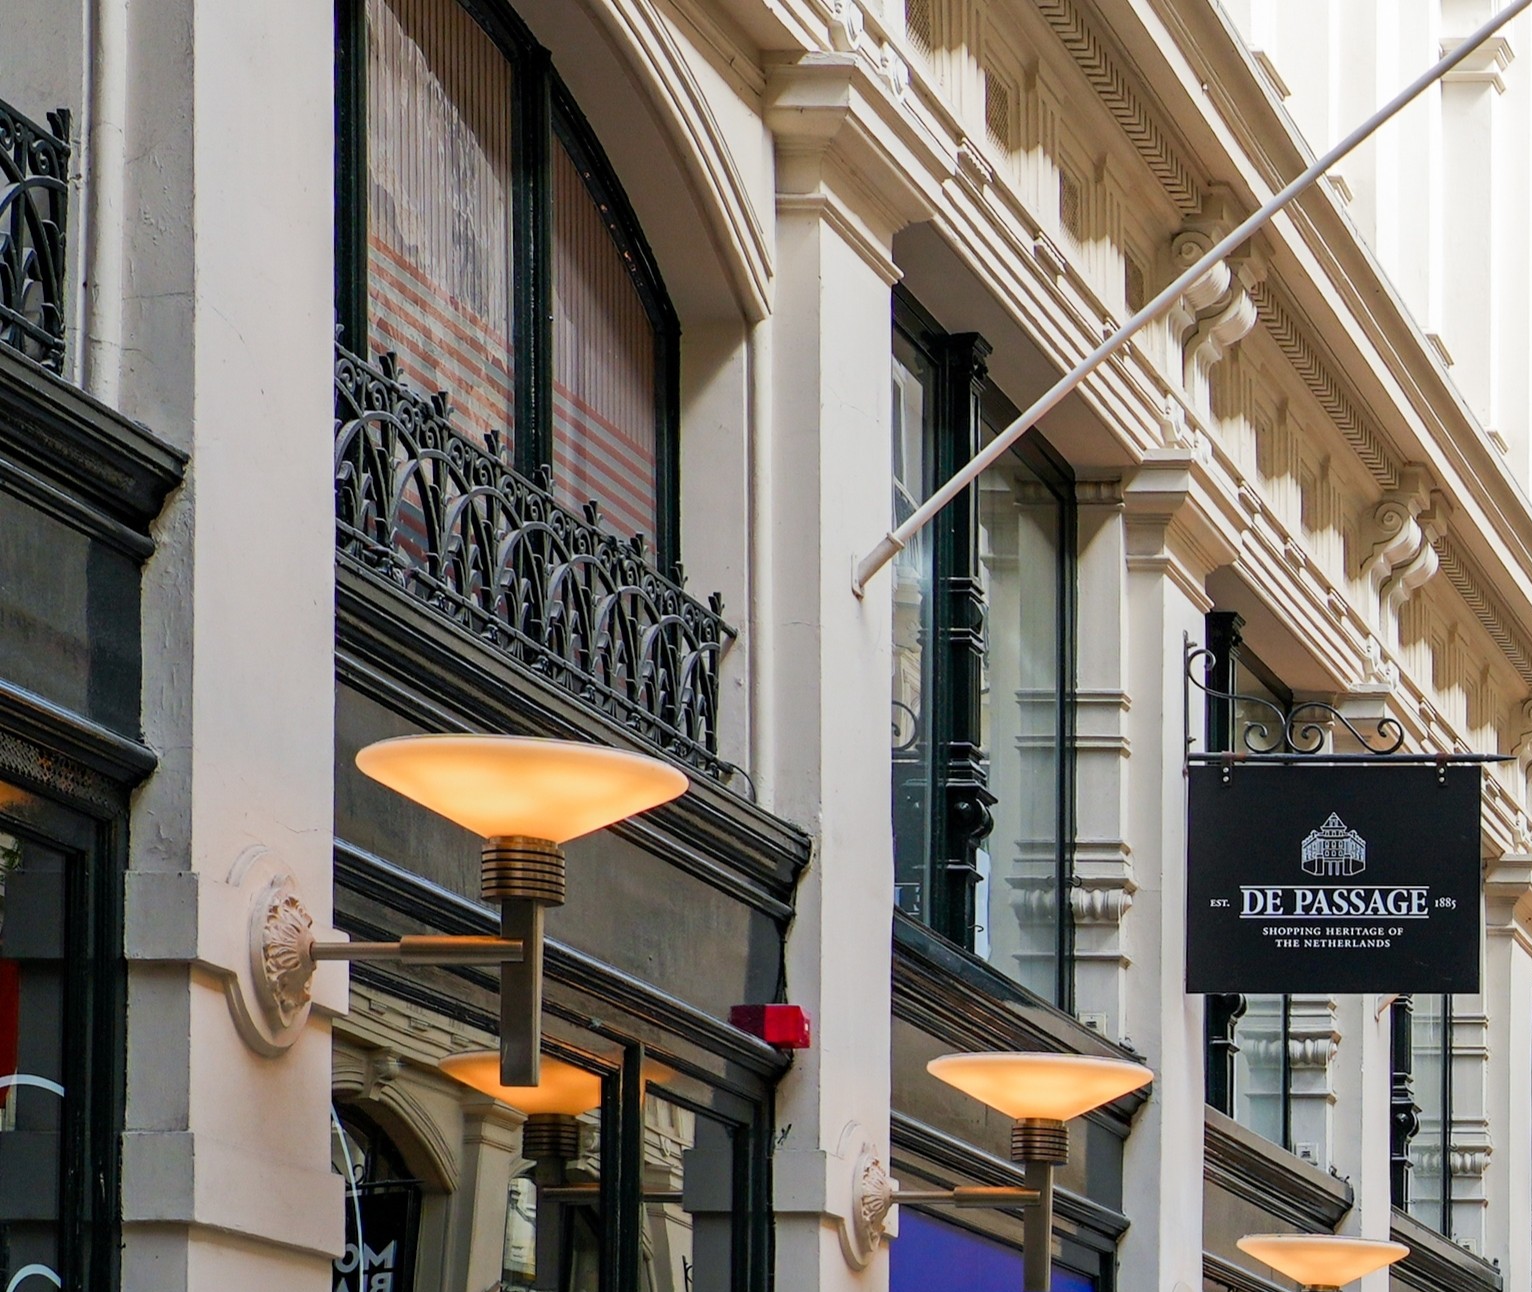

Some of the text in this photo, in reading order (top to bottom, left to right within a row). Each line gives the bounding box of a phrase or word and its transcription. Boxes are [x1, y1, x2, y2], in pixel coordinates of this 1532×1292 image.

[1210, 889, 1456, 915] EST. DE PASSAGE 1885
[1262, 926, 1404, 936] SHOPPING HERITAGE OF
[1275, 938, 1391, 948] THE NETHERLANDS
